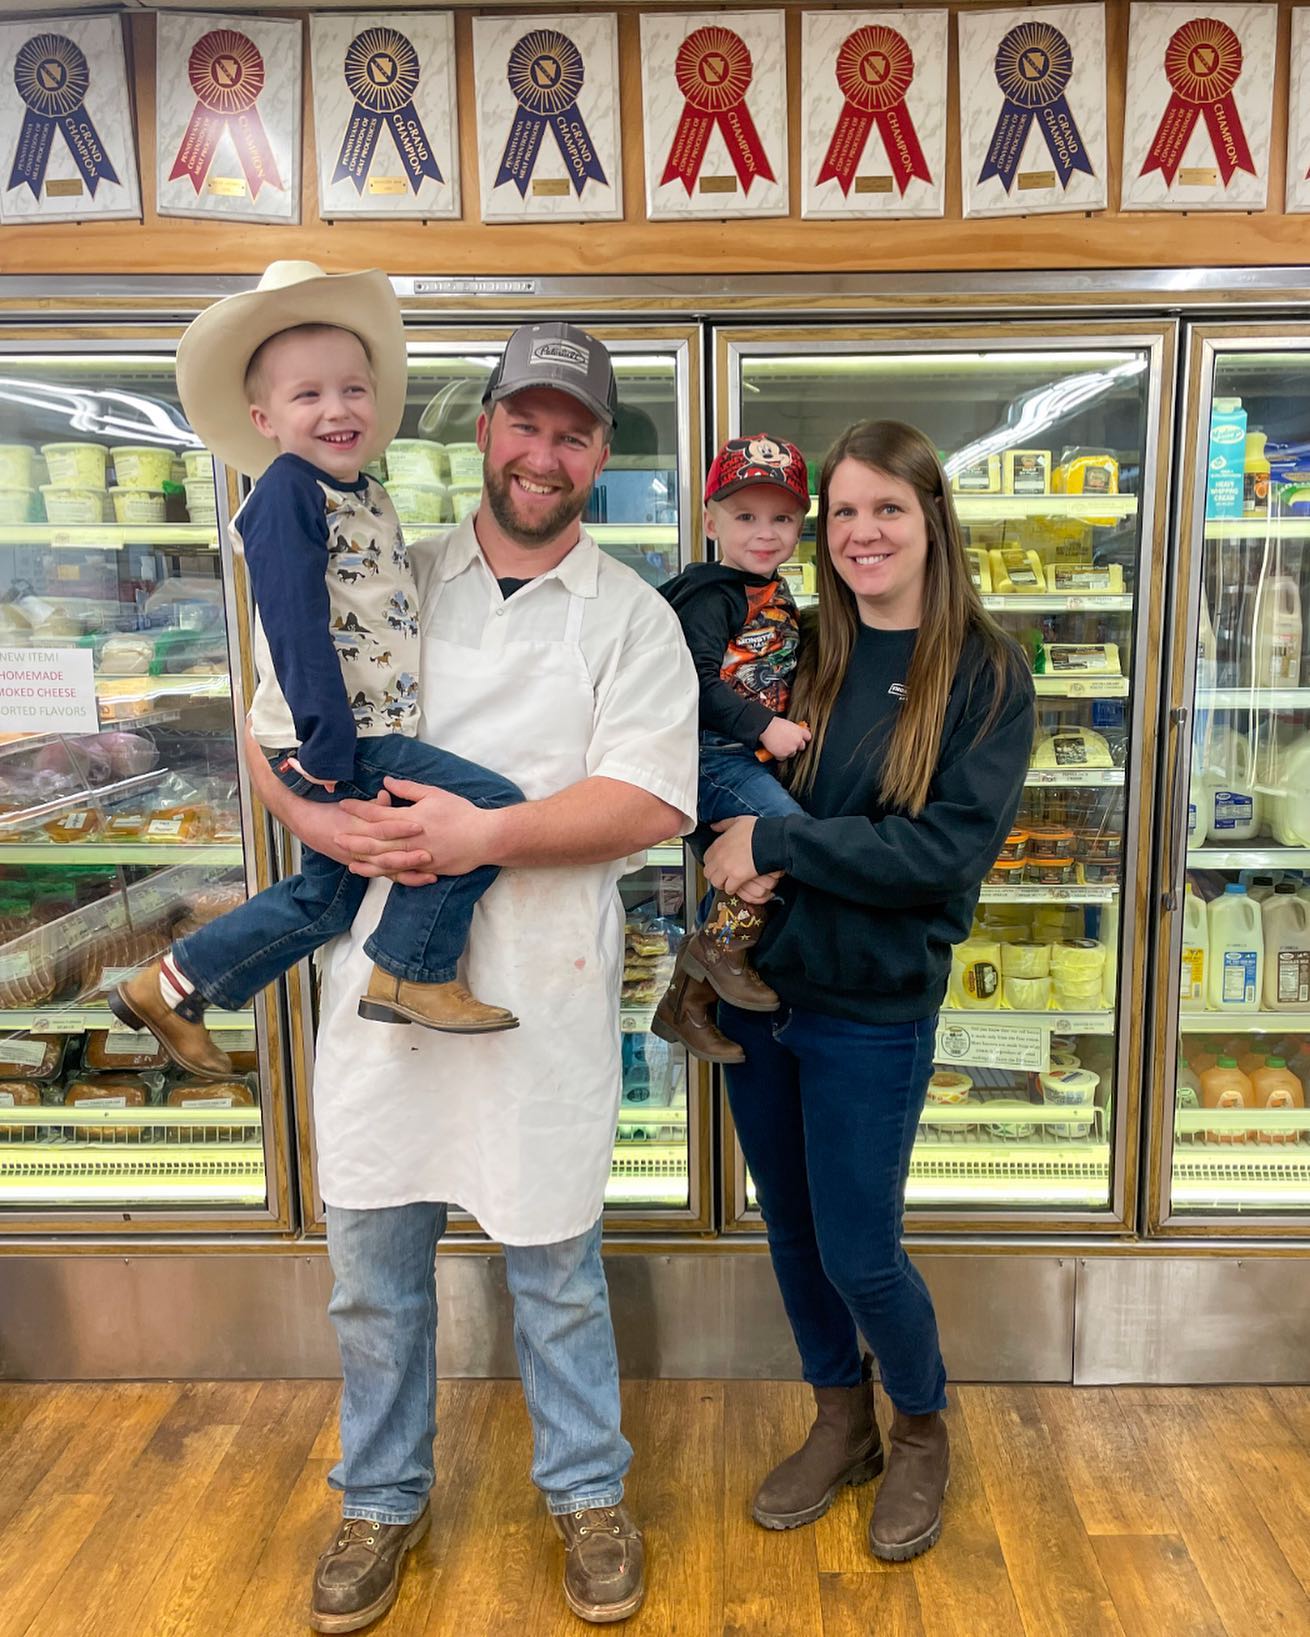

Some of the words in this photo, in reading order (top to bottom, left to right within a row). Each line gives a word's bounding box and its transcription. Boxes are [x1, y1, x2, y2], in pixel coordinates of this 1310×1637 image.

[66, 118, 98, 177] CHAMPION
[80, 124, 102, 162] GRAND
[348, 128, 366, 172] CONVENTION
[393, 114, 423, 176] CHAMPION
[407, 120, 428, 160] GRAND
[556, 116, 586, 177] CHAMPION
[570, 122, 592, 162] GRAND
[728, 112, 758, 172] CHAMPION
[886, 112, 914, 173] CHAMPION
[1044, 108, 1072, 168] CHAMPION
[1058, 114, 1078, 154] GRAND
[1160, 119, 1181, 162] CONVENTION
[1214, 104, 1238, 165] CHAMPION
[356, 158, 365, 176] MEAT
[1167, 150, 1176, 167] MEAT
[0, 652, 24, 662] NEW
[0, 670, 64, 681] HOMEMADE
[38, 688, 76, 698] CHEESE
[40, 706, 86, 716] FLAVORS
